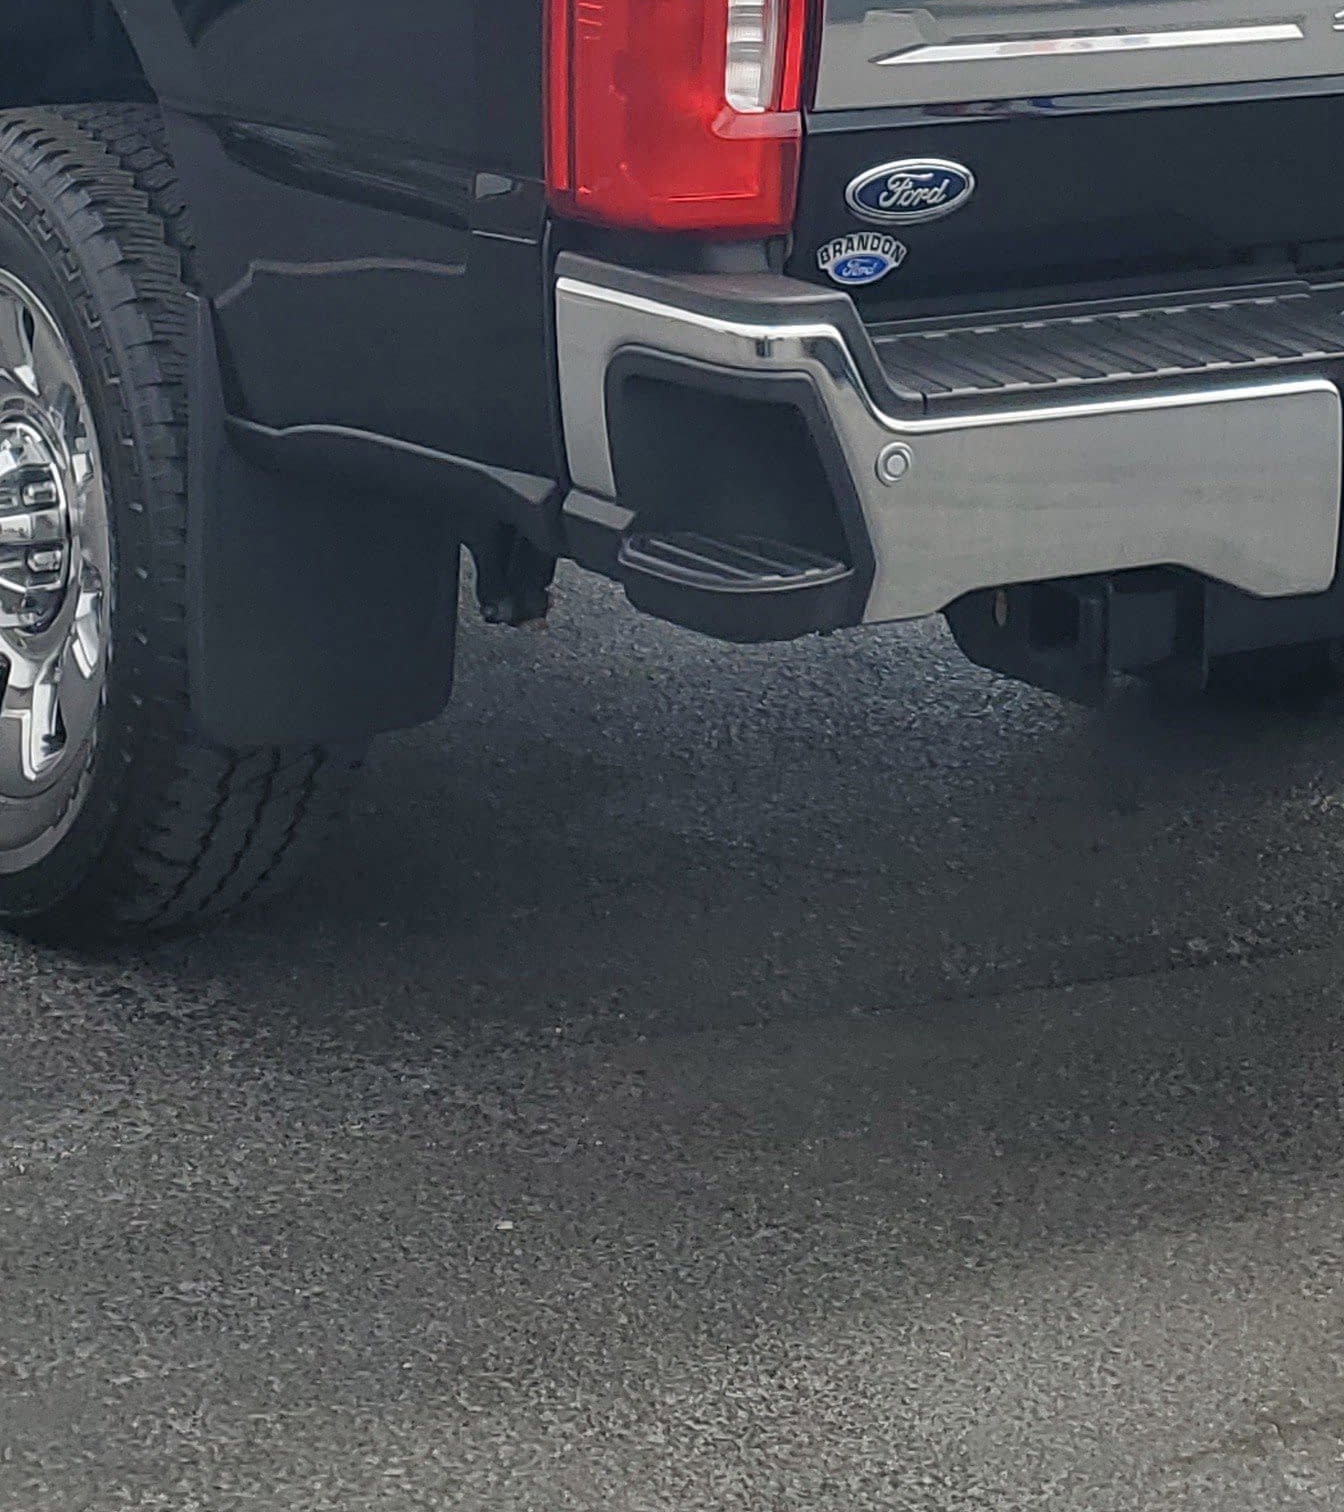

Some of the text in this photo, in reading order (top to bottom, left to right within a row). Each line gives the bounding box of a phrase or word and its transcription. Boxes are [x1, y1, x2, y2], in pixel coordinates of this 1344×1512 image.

[877, 171, 952, 209] Ford
[818, 232, 906, 267] BRANDON
[841, 257, 879, 277] Ford
